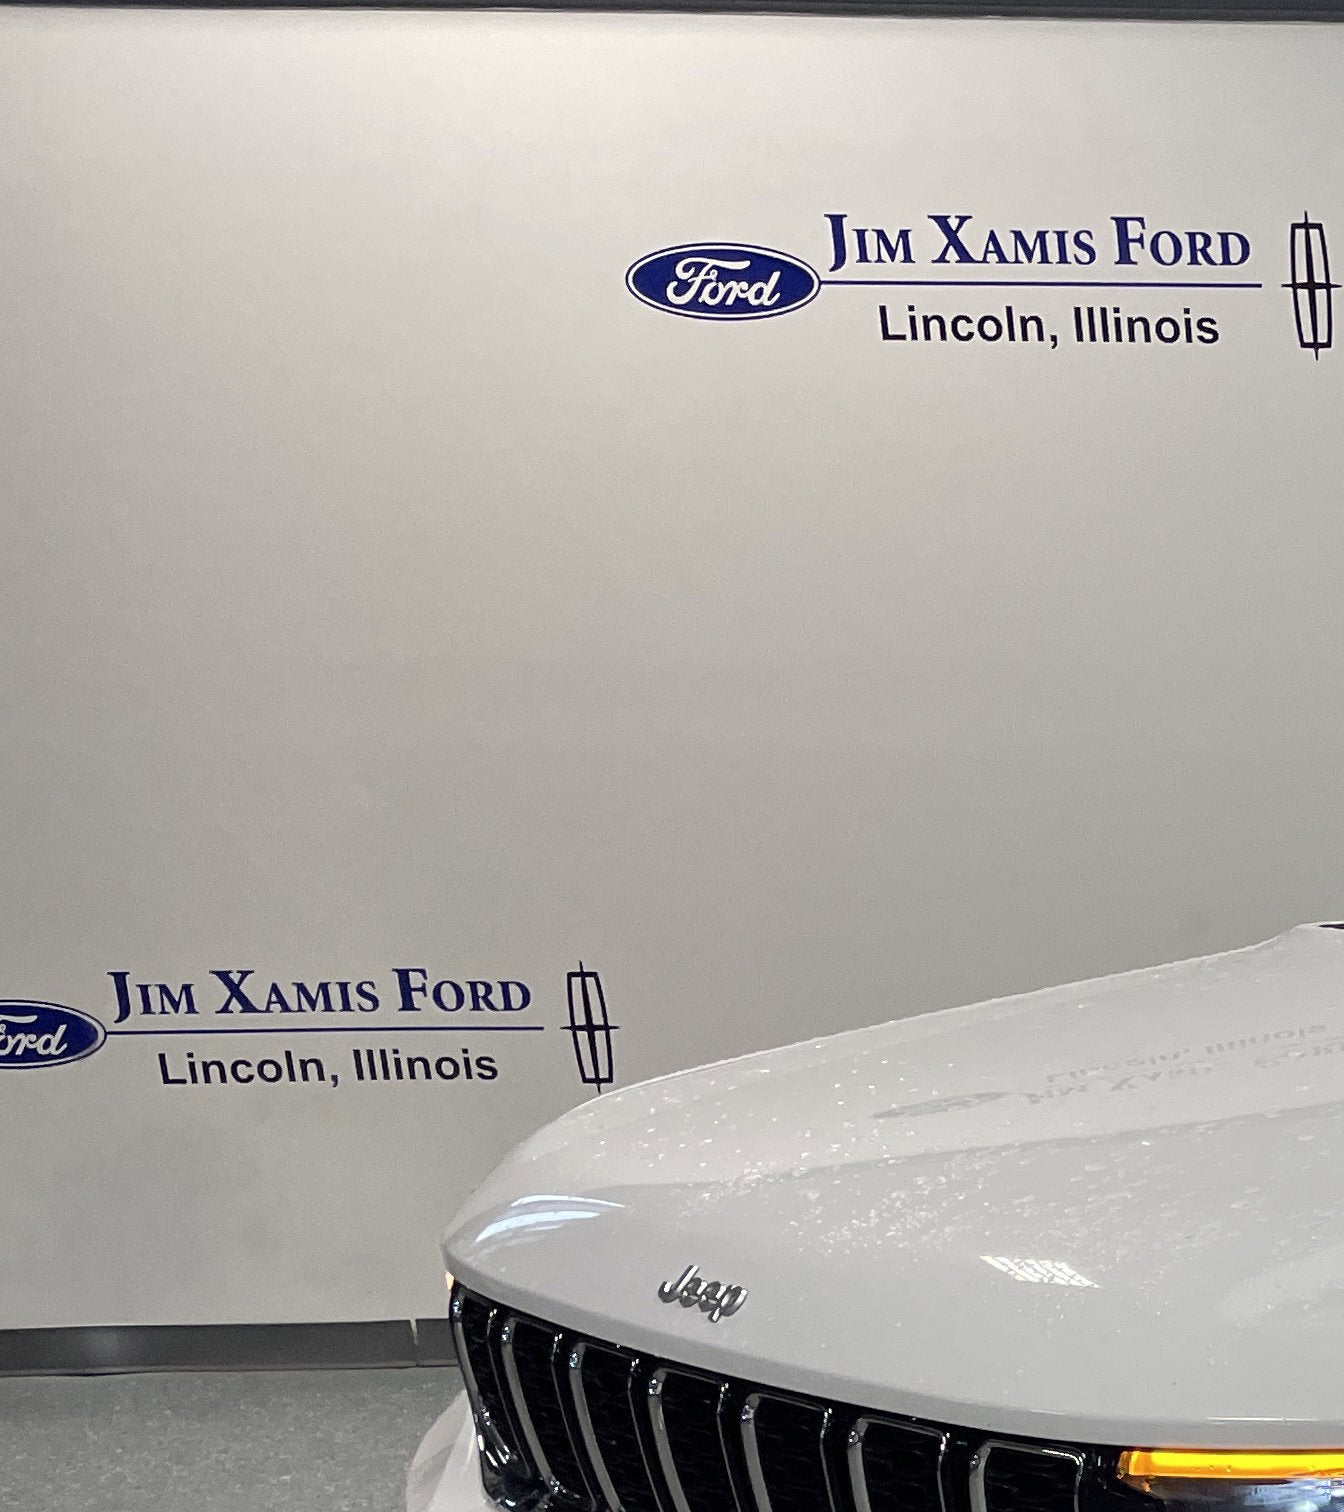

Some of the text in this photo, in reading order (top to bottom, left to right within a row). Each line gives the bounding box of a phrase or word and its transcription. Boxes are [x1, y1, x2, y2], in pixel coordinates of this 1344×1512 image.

[823, 212, 1251, 273] JIM XAMIS FORD
[665, 257, 782, 307] Ford
[878, 305, 1221, 350] Lincoln, Illinois
[106, 967, 531, 1024] JIM XAMIS FORD
[157, 1048, 499, 1088] Lincoln, Illinois
[658, 1264, 748, 1323] Jeep
